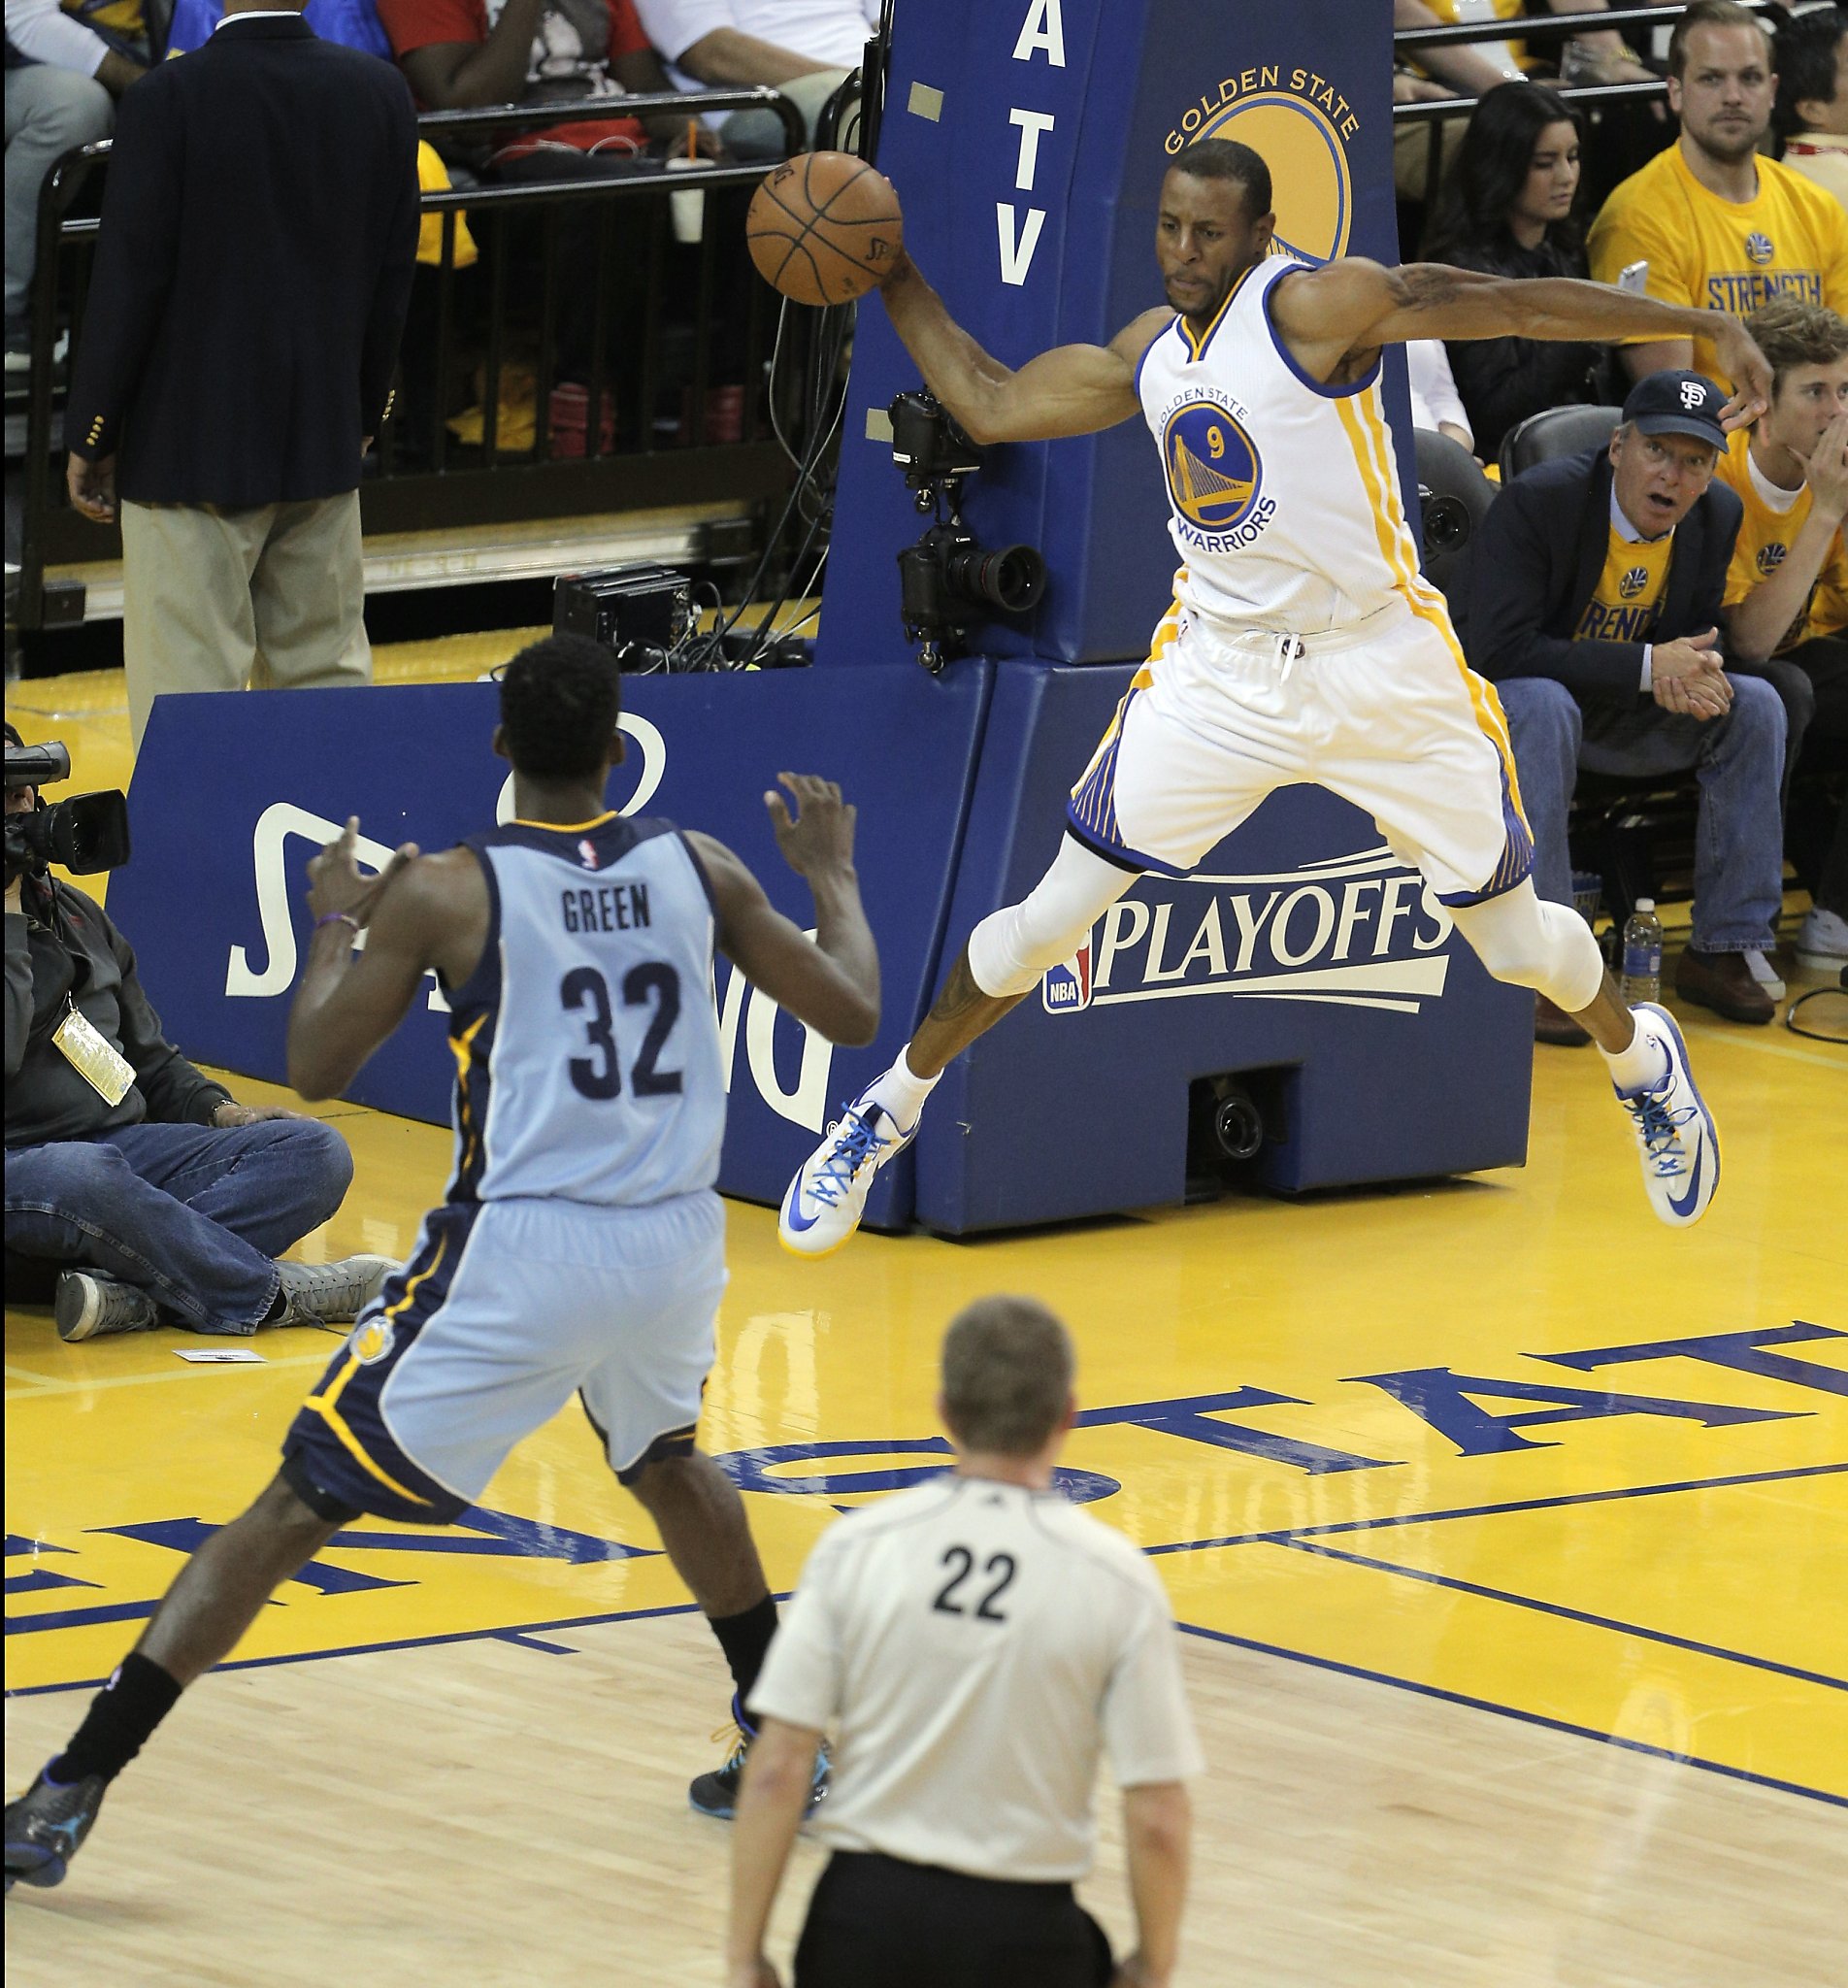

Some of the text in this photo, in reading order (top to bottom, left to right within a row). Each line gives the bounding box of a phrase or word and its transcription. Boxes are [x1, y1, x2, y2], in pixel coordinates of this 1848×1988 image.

[1165, 66, 1360, 155] GOLDEN STATE
[1207, 387, 1248, 421] STATE
[1206, 425, 1225, 459] 9
[1176, 496, 1277, 553] WARRIORS
[562, 884, 651, 933] GREEN
[1093, 874, 1454, 988] PLAYOFFS
[1050, 982, 1077, 1003] NBA
[560, 960, 683, 1101] 32
[933, 1545, 1015, 1620] 22
